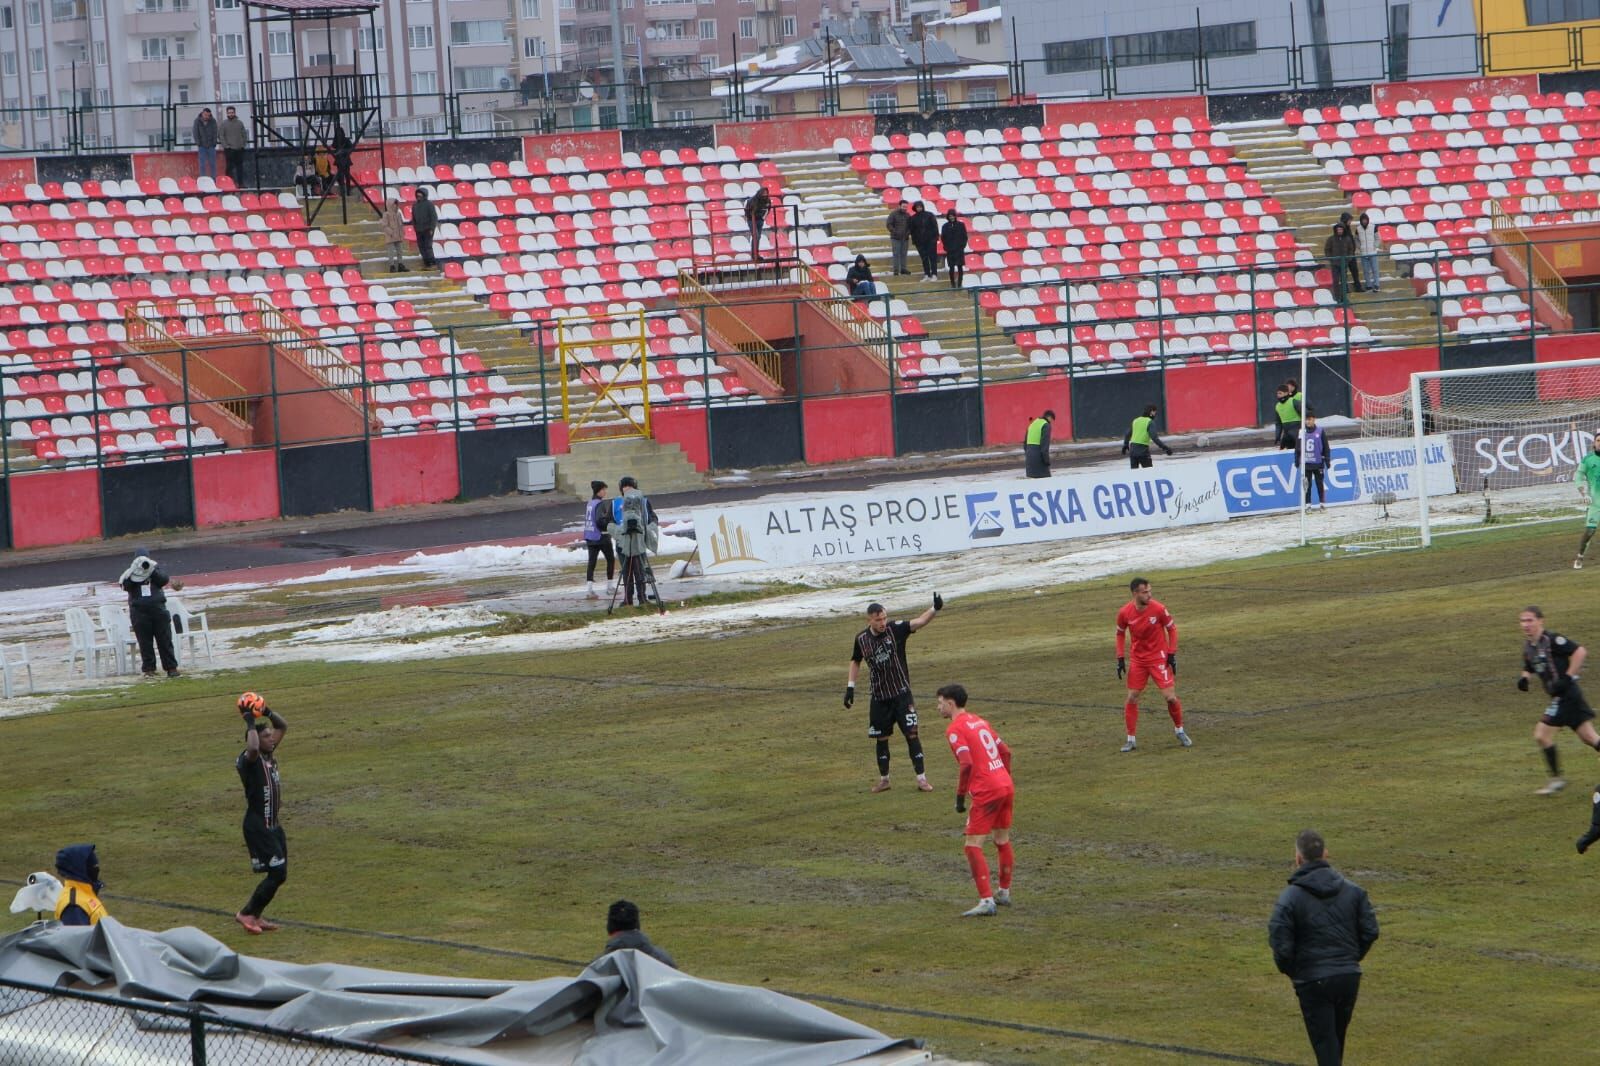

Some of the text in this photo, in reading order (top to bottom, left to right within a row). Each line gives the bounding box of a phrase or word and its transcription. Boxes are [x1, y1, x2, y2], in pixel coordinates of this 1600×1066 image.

[1360, 443, 1446, 471] MÜHENDİLİK
[1225, 457, 1353, 508] ÇEVE
[766, 494, 960, 536] ALTAŞ PROJE
[1009, 488, 1087, 529] ESKA
[1093, 479, 1175, 520] GRUP
[812, 534, 923, 558] ADİL ALTAŞ
[978, 729, 998, 760] 9
